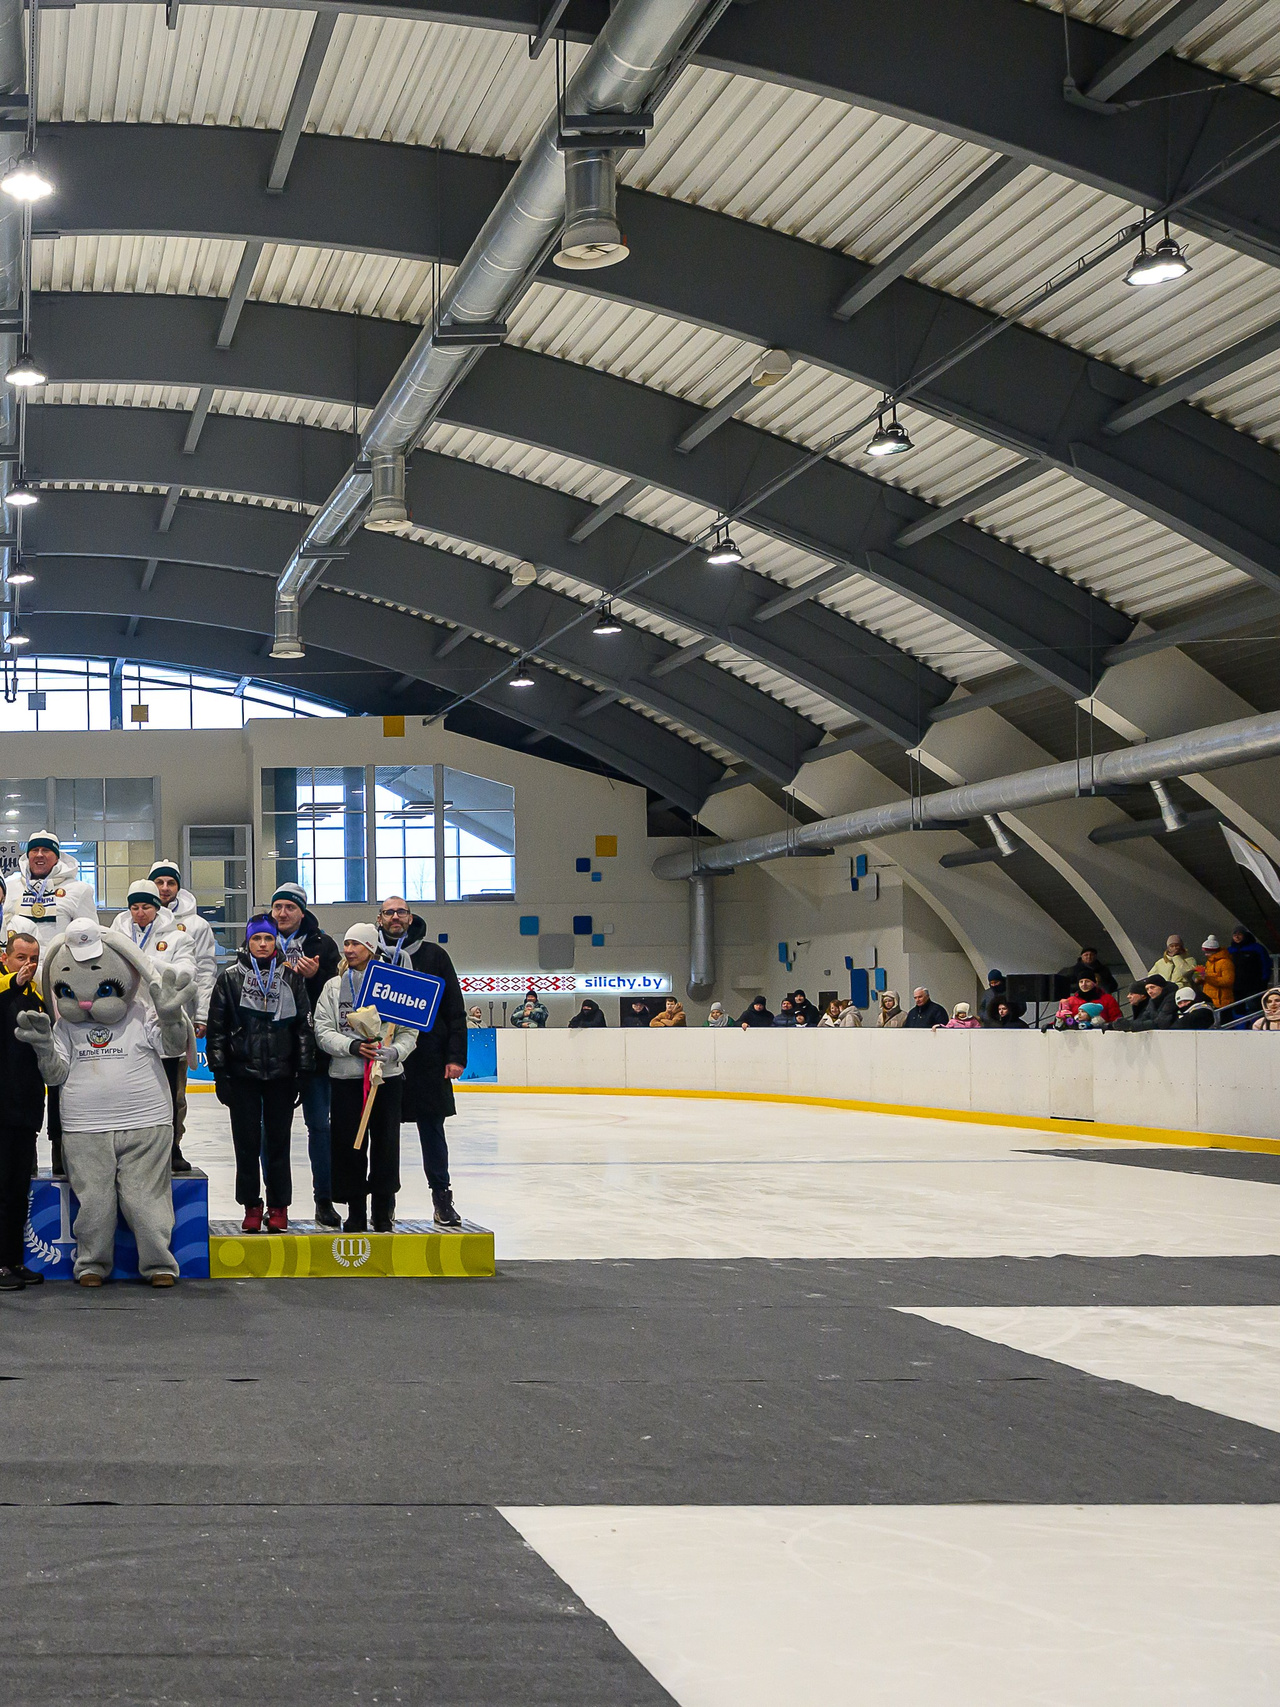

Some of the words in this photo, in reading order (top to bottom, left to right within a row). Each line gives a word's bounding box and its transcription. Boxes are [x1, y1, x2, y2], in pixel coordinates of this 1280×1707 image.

[584, 976, 663, 989] silichy.by
[371, 982, 427, 1010] Единые
[79, 1048, 100, 1057] БЕЛЫЕ
[101, 1047, 123, 1055] ТИГРЫ
[339, 1238, 364, 1257] III
